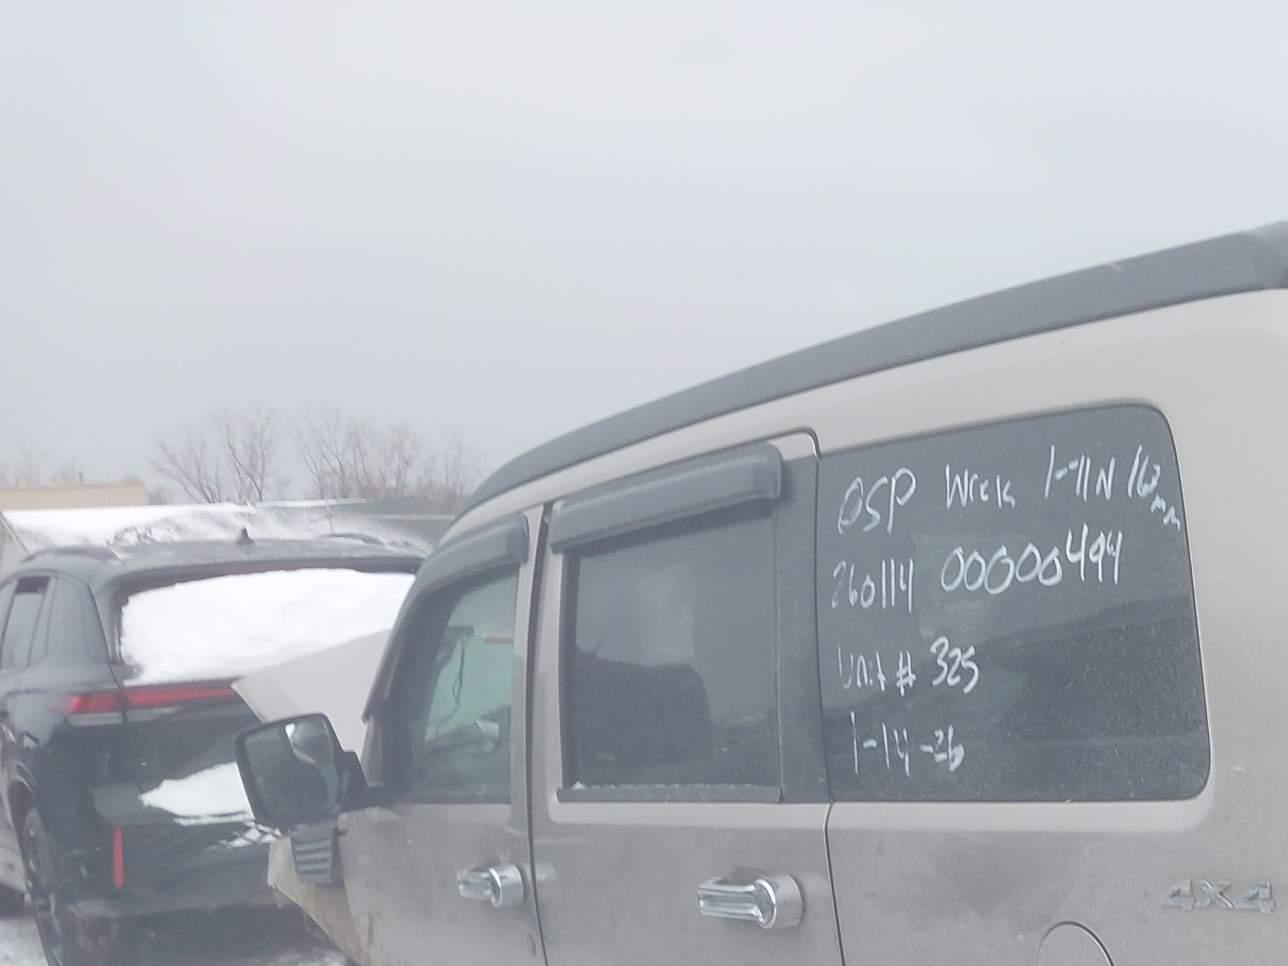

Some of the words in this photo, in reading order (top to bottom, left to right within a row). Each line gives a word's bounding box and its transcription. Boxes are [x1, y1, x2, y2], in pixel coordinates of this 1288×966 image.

[837, 467, 917, 535] OSP
[831, 558, 914, 613] 260114
[930, 635, 979, 694] 325
